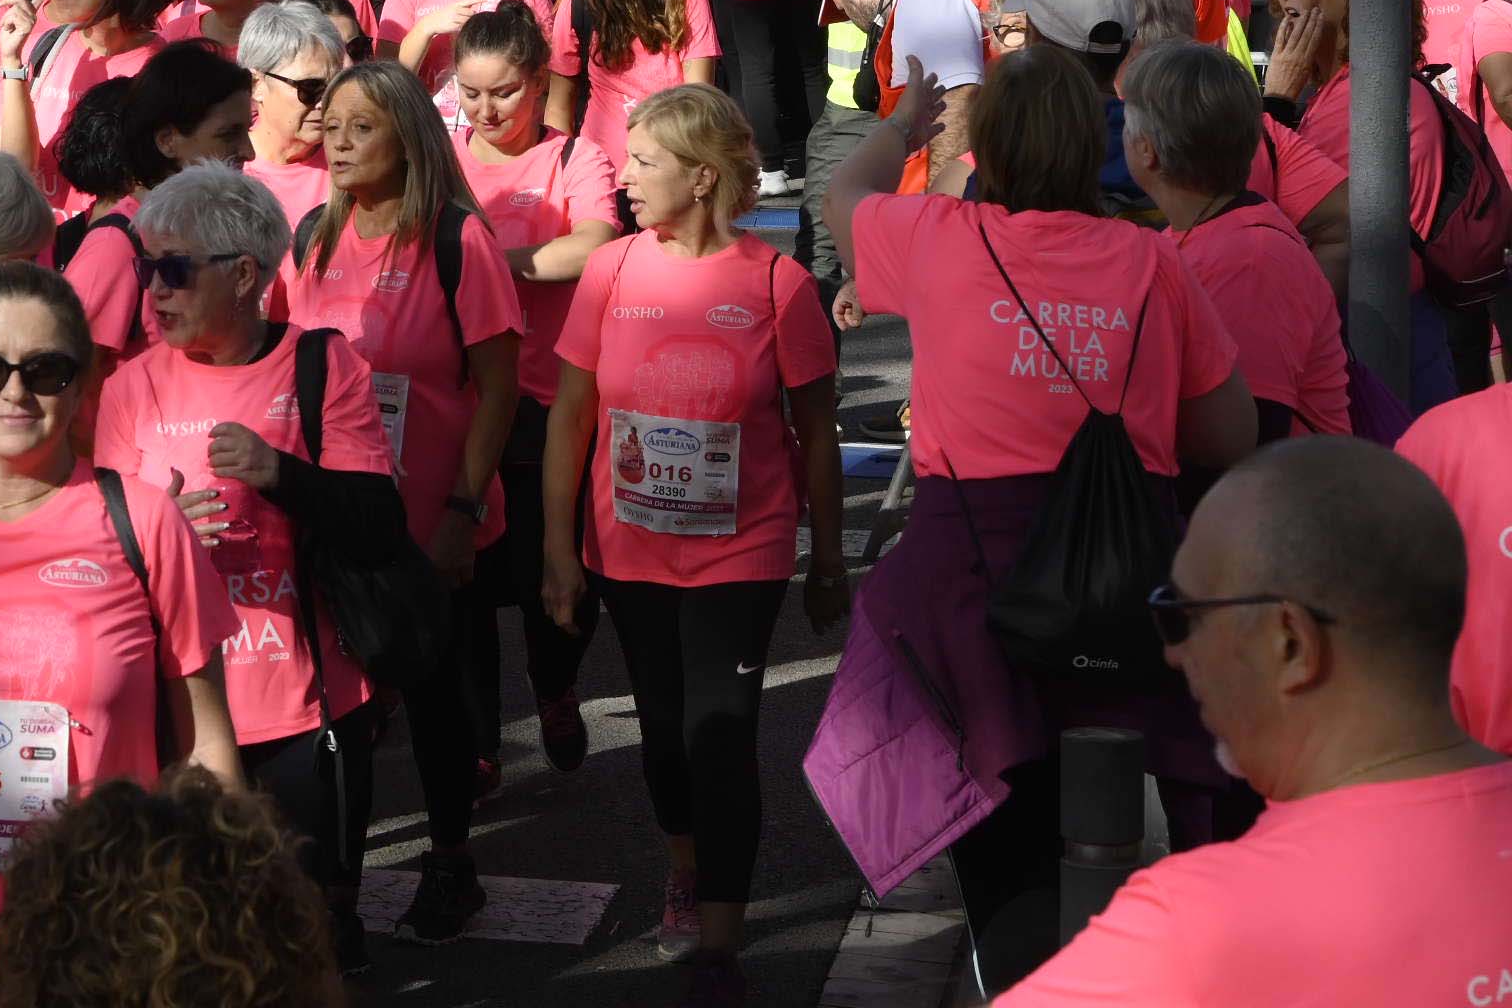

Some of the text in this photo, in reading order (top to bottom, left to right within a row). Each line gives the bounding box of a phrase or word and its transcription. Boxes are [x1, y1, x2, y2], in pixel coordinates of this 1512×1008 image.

[613, 307, 663, 320] OYSHO
[990, 300, 1129, 330] CARRERA
[1019, 327, 1104, 354] DE LA
[1009, 353, 1110, 382] MUJER
[1048, 383, 1074, 395] 2023
[156, 418, 217, 436] OYSHO
[648, 434, 696, 450] ASTURIANA
[649, 463, 692, 482] 016
[652, 485, 686, 497] 28390
[654, 500, 665, 508] DE
[44, 569, 103, 584] ASTURIANA
[1089, 657, 1119, 669] cinfa
[20, 724, 55, 734] SUMA
